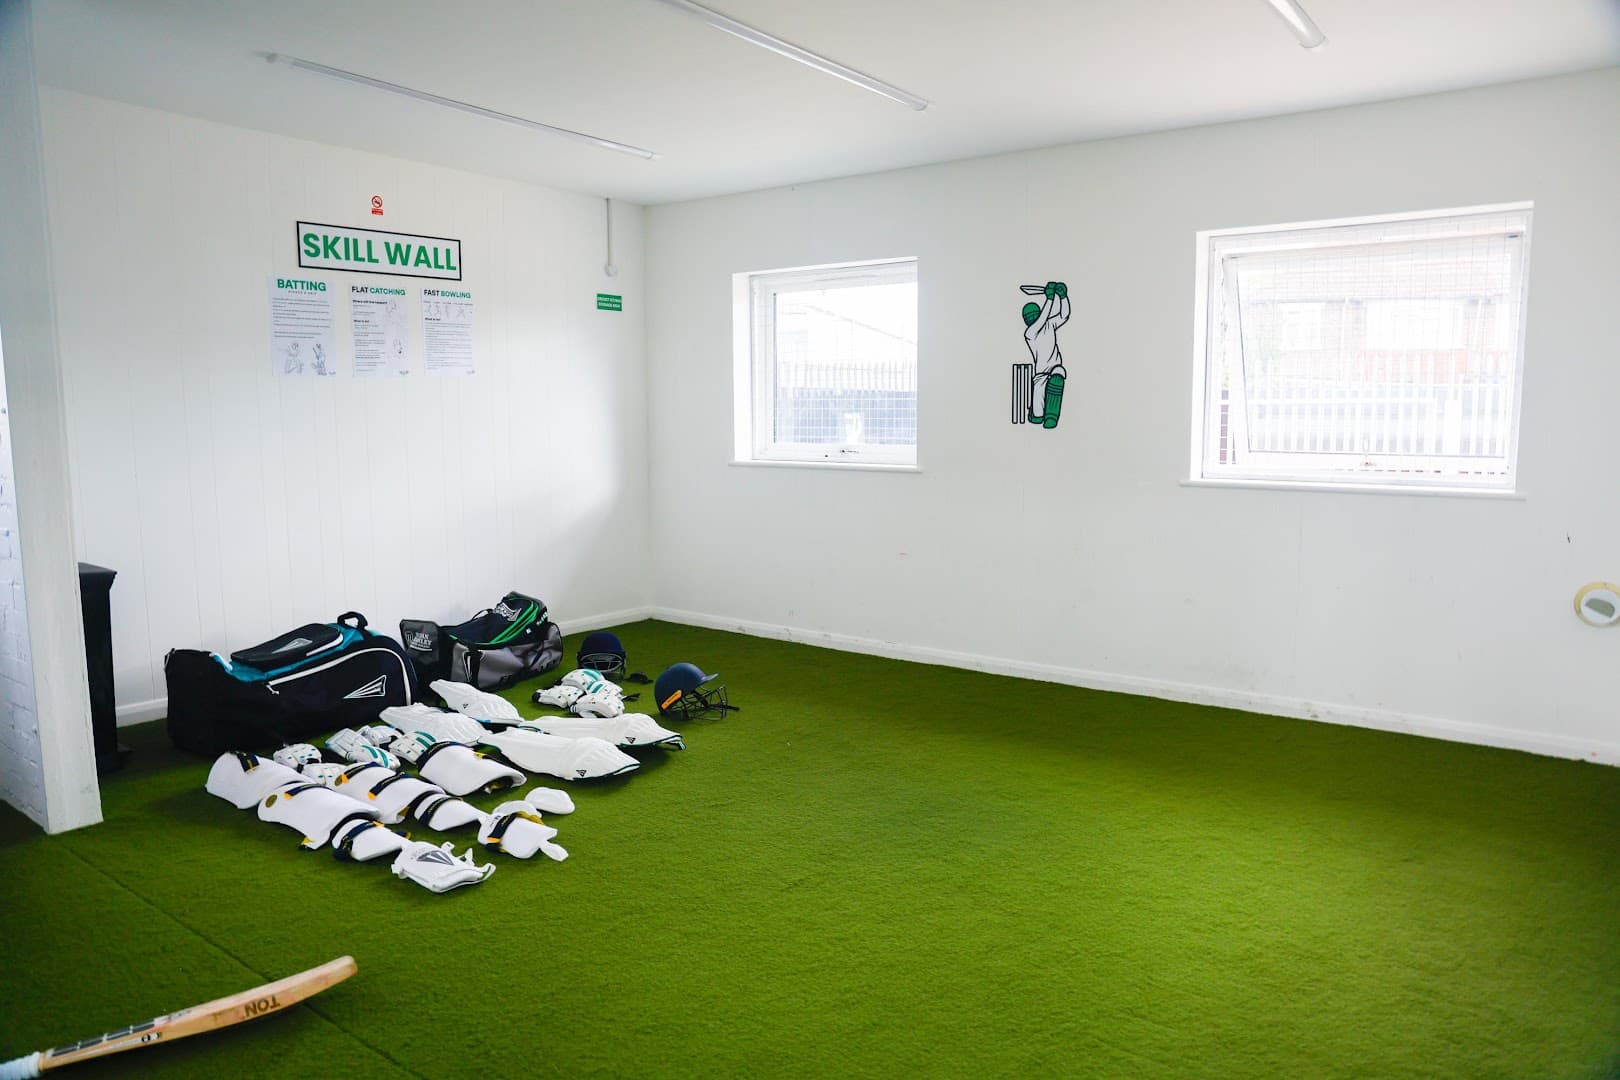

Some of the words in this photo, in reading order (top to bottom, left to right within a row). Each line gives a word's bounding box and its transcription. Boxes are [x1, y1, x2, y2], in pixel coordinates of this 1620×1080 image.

[302, 233, 380, 264] SKILL
[384, 241, 457, 271] WALL
[277, 278, 327, 292] BATTING
[369, 287, 406, 296] CATCHING
[423, 289, 440, 297] FAST
[440, 290, 471, 299] BOWLING
[244, 995, 281, 1017] TON
